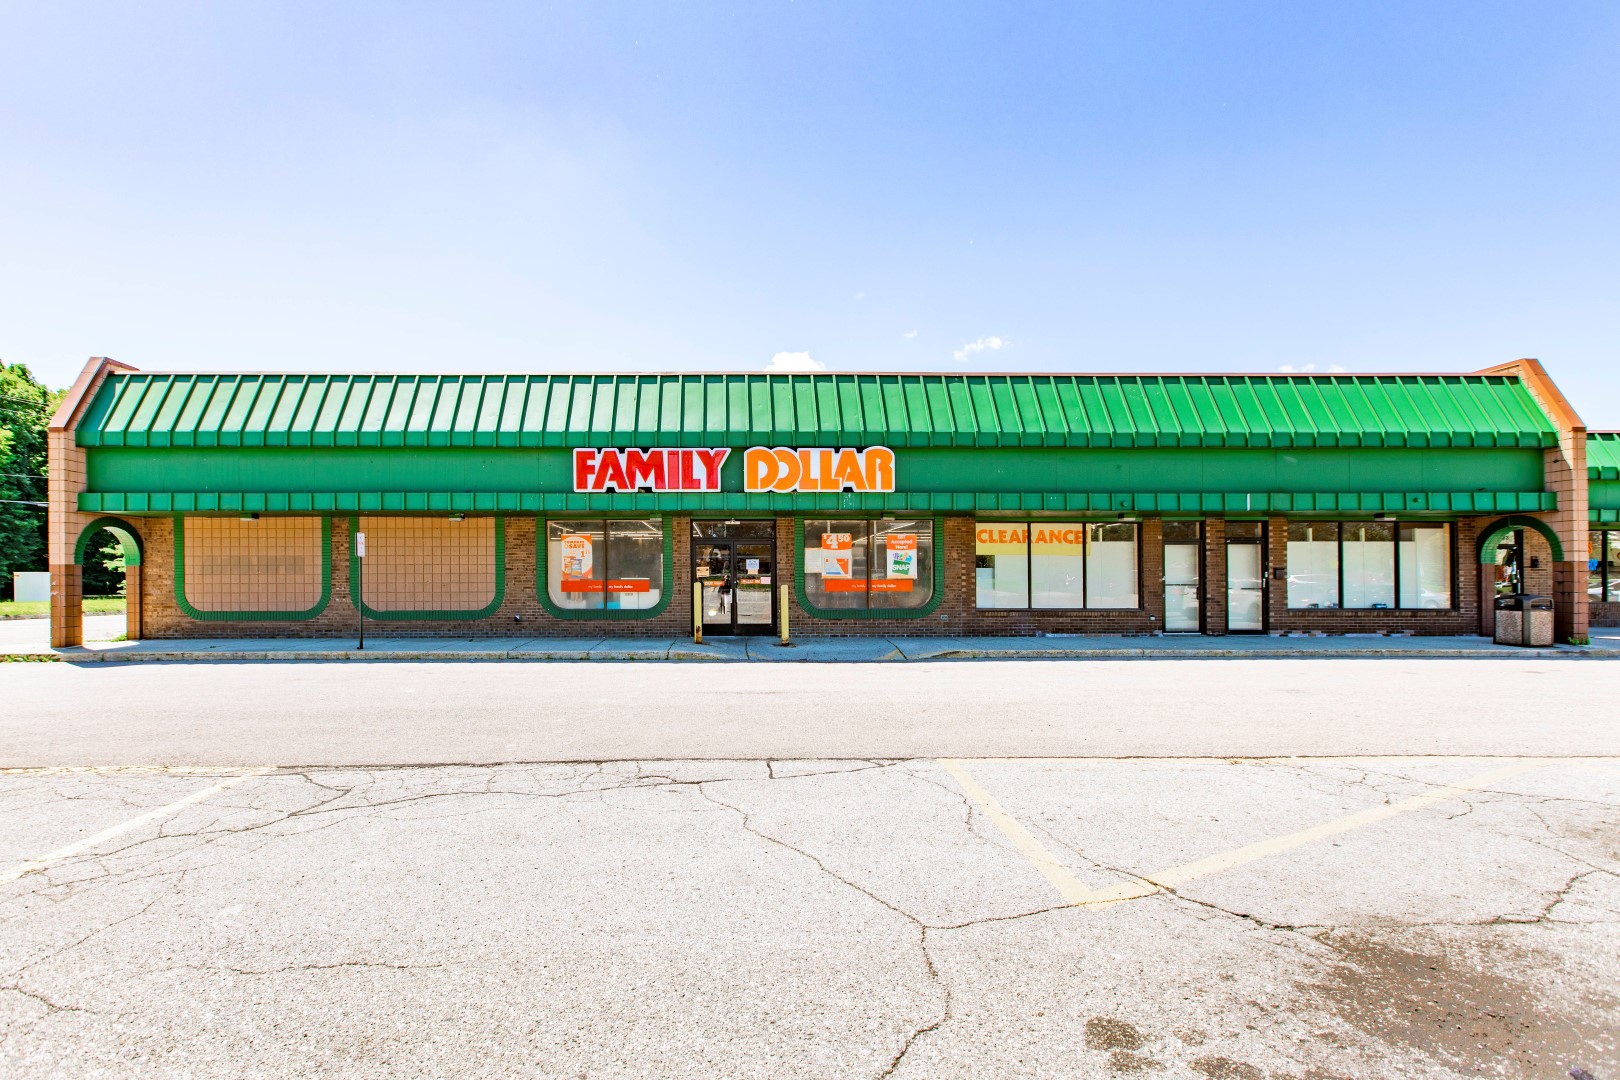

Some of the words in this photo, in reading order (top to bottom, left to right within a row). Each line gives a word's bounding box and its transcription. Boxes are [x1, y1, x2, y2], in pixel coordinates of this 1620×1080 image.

[574, 449, 730, 491] FAMILY
[744, 447, 895, 492] DOLLAR
[892, 563, 911, 571] SNAP
